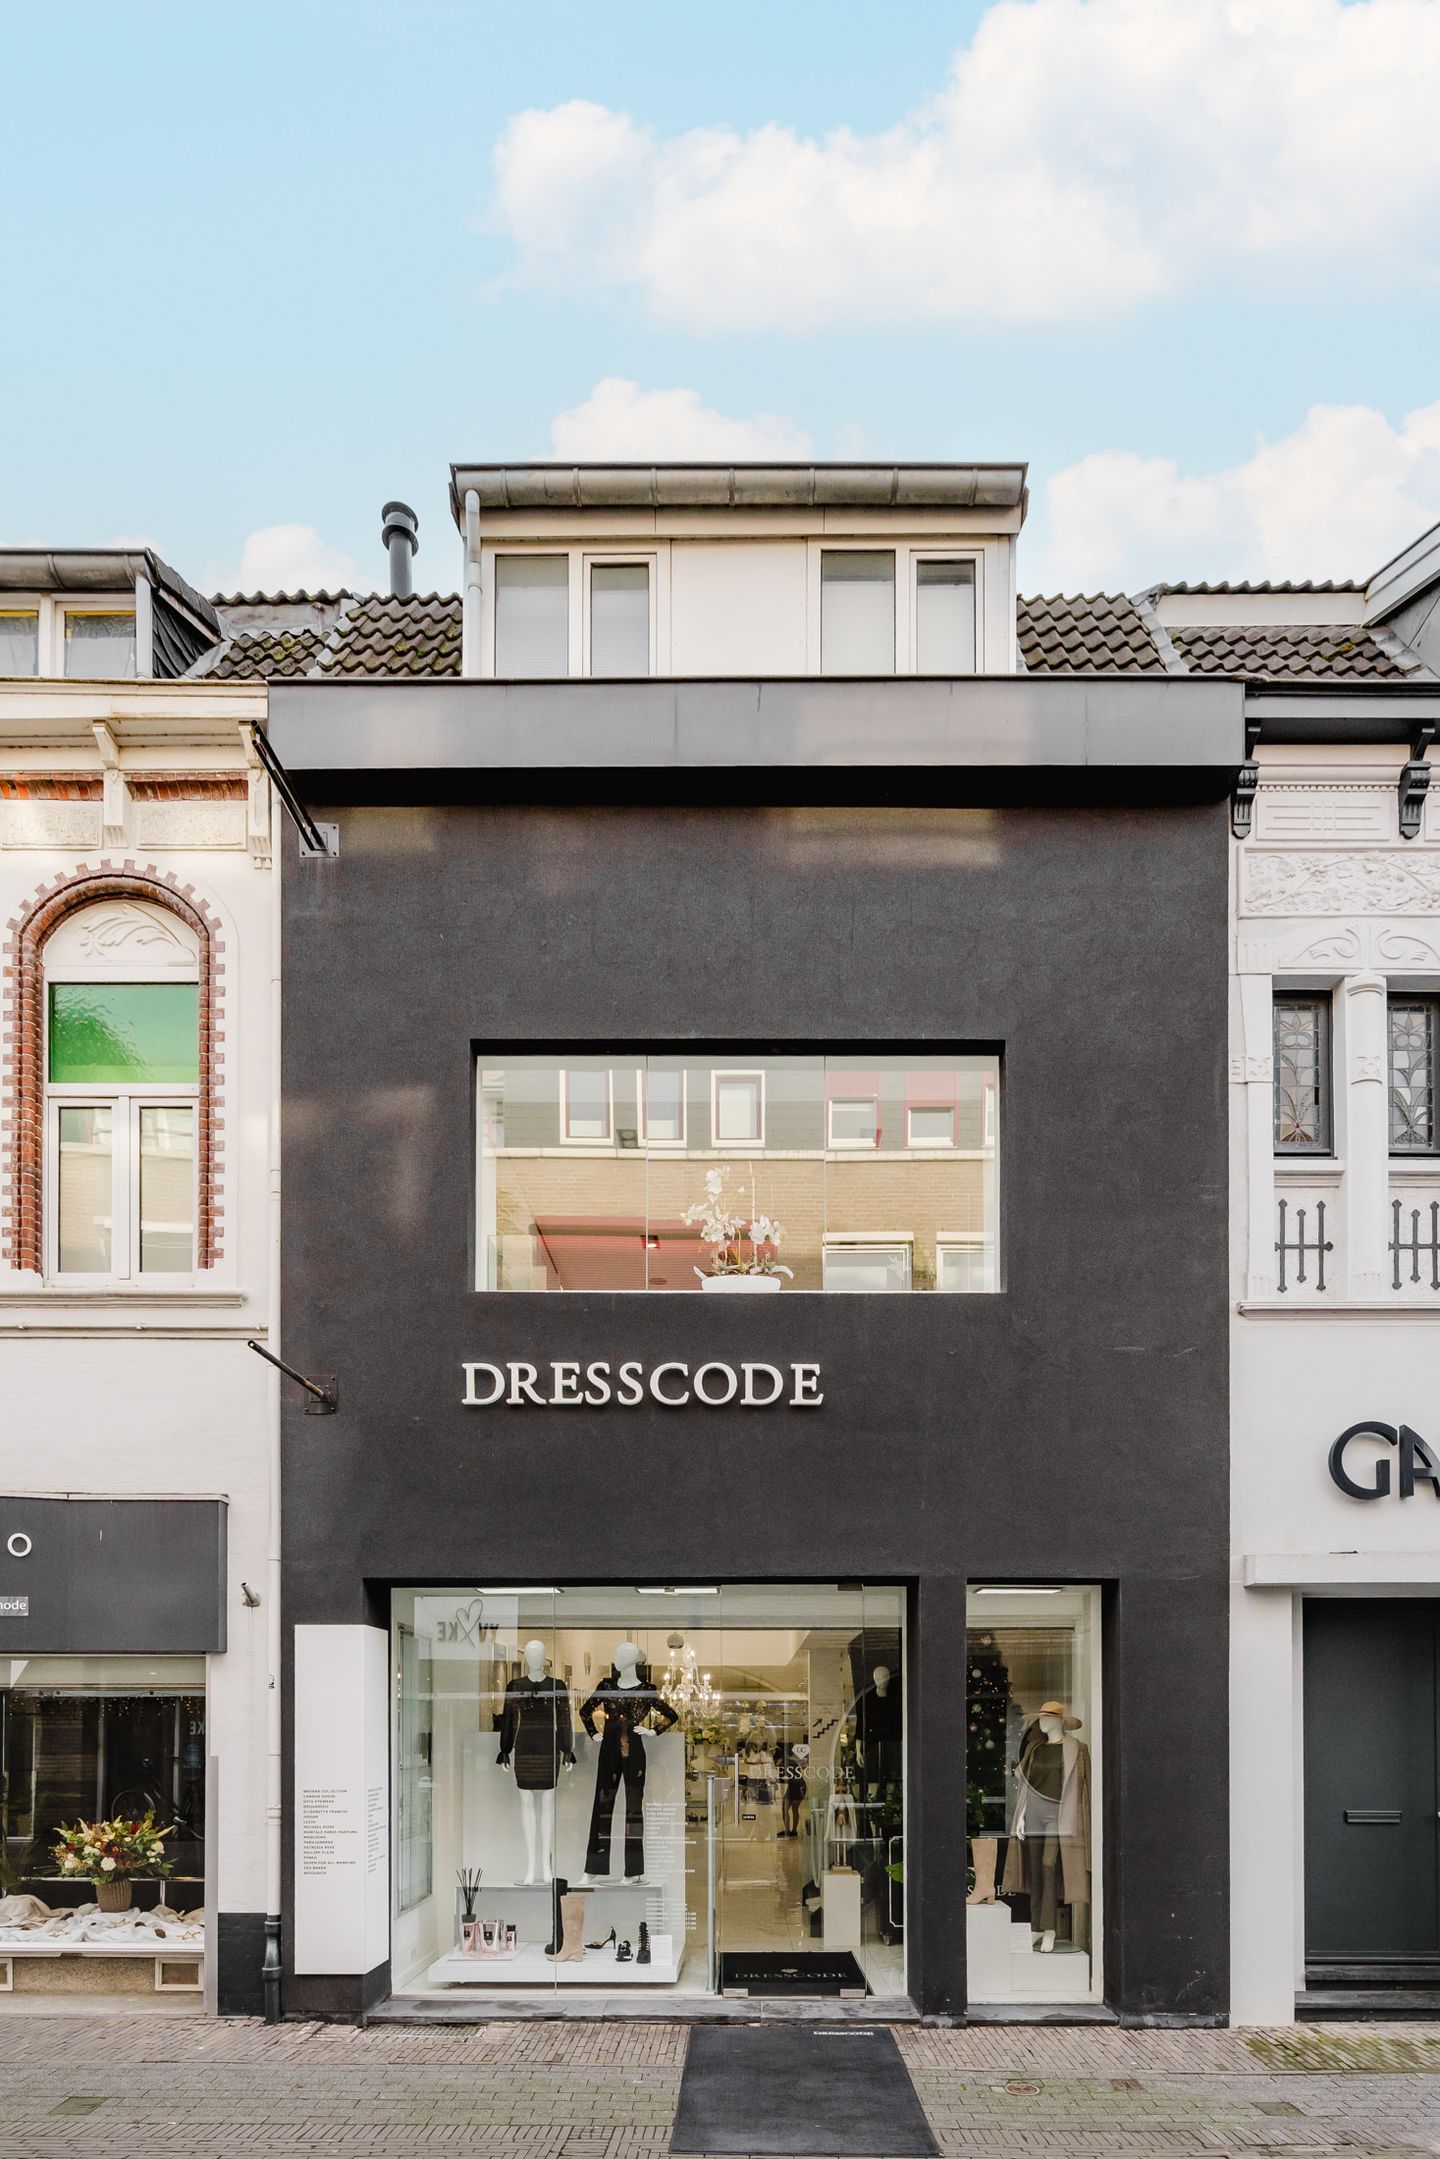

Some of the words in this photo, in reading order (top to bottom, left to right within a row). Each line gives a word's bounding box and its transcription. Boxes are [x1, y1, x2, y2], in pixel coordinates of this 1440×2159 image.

[461, 1362, 824, 1406] DRESSCODE
[1328, 1421, 1440, 1500] GA
[750, 1766, 856, 1780] DRESSCODE
